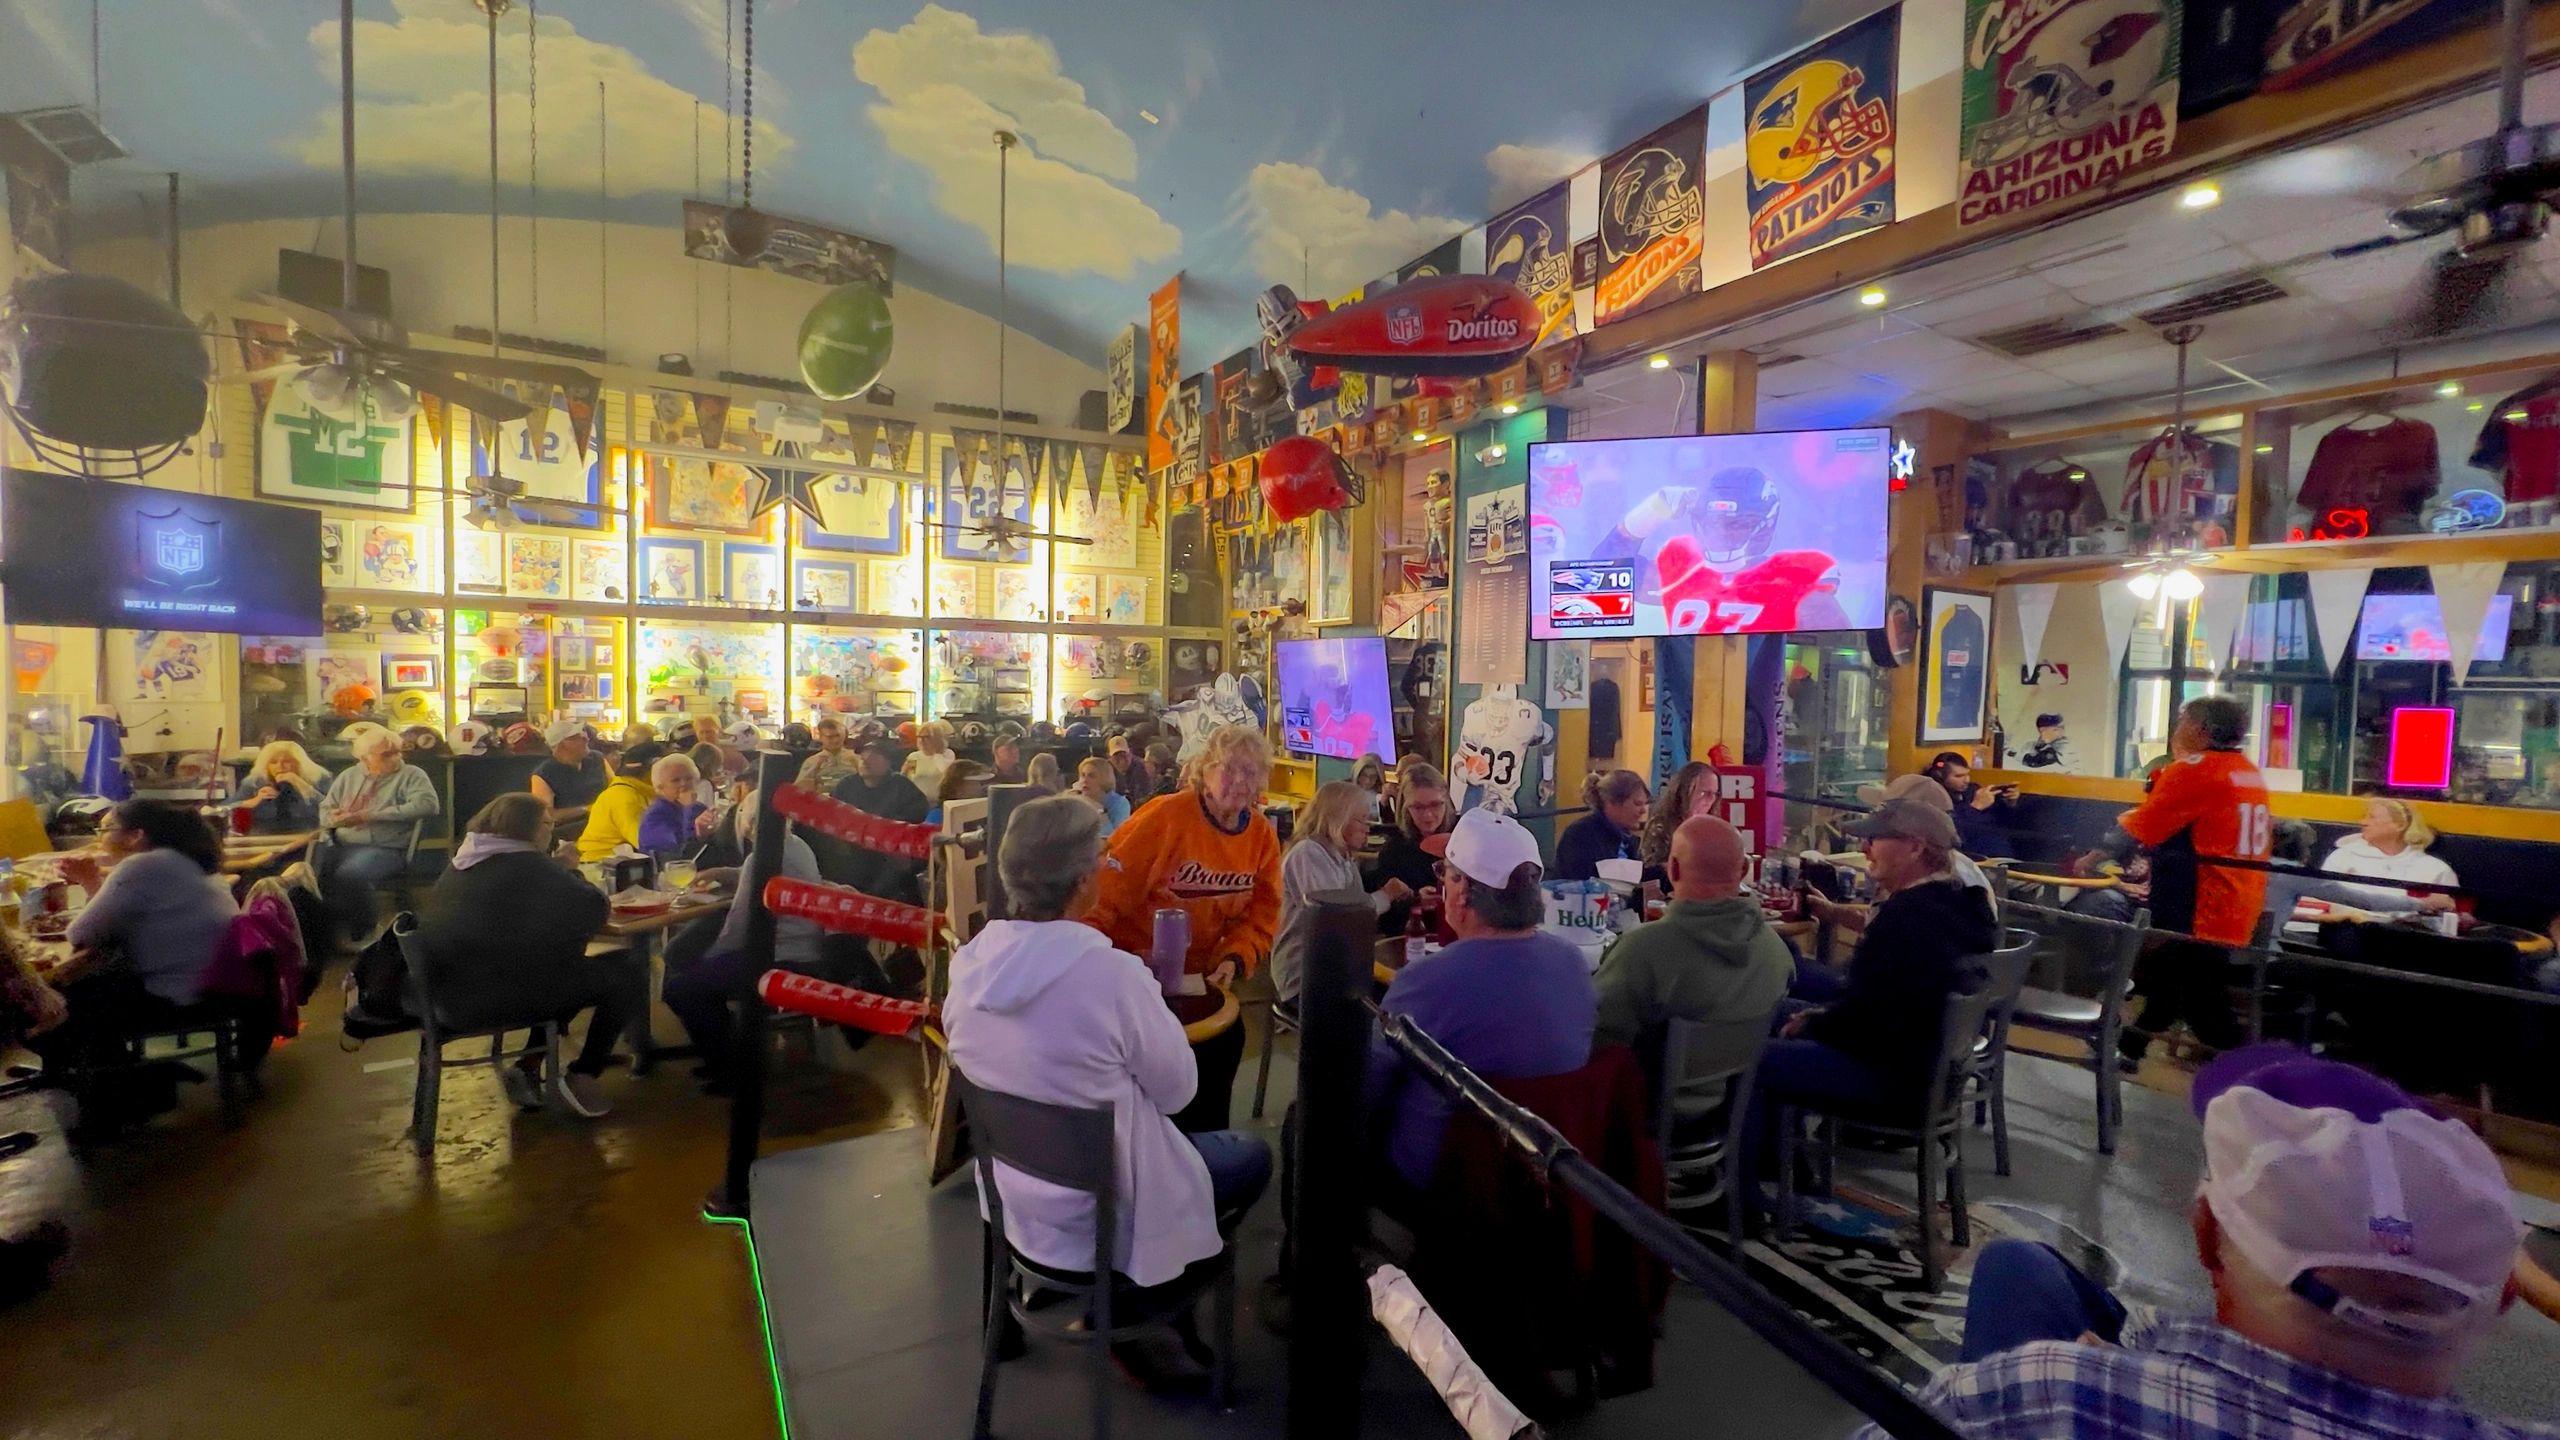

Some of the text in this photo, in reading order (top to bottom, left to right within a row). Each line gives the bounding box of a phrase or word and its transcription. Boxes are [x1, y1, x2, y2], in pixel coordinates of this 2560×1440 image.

[1964, 102, 2166, 200] ARIZONA
[1960, 136, 2166, 226] CARDINALS
[1757, 149, 1882, 253] PATRIOTS
[1602, 234, 1691, 315] FALCONS
[1390, 316, 1420, 340] NFL
[1448, 315, 1518, 342] Doritos
[519, 427, 560, 464] 12
[163, 548, 198, 567] NFL
[1609, 572, 1630, 588] 10
[124, 599, 236, 614] WE'LL BE RIGHT BACK
[1618, 597, 1630, 612] 7
[1480, 747, 1516, 785] 33
[2239, 802, 2270, 856] 18
[1178, 862, 1256, 887] Bronco
